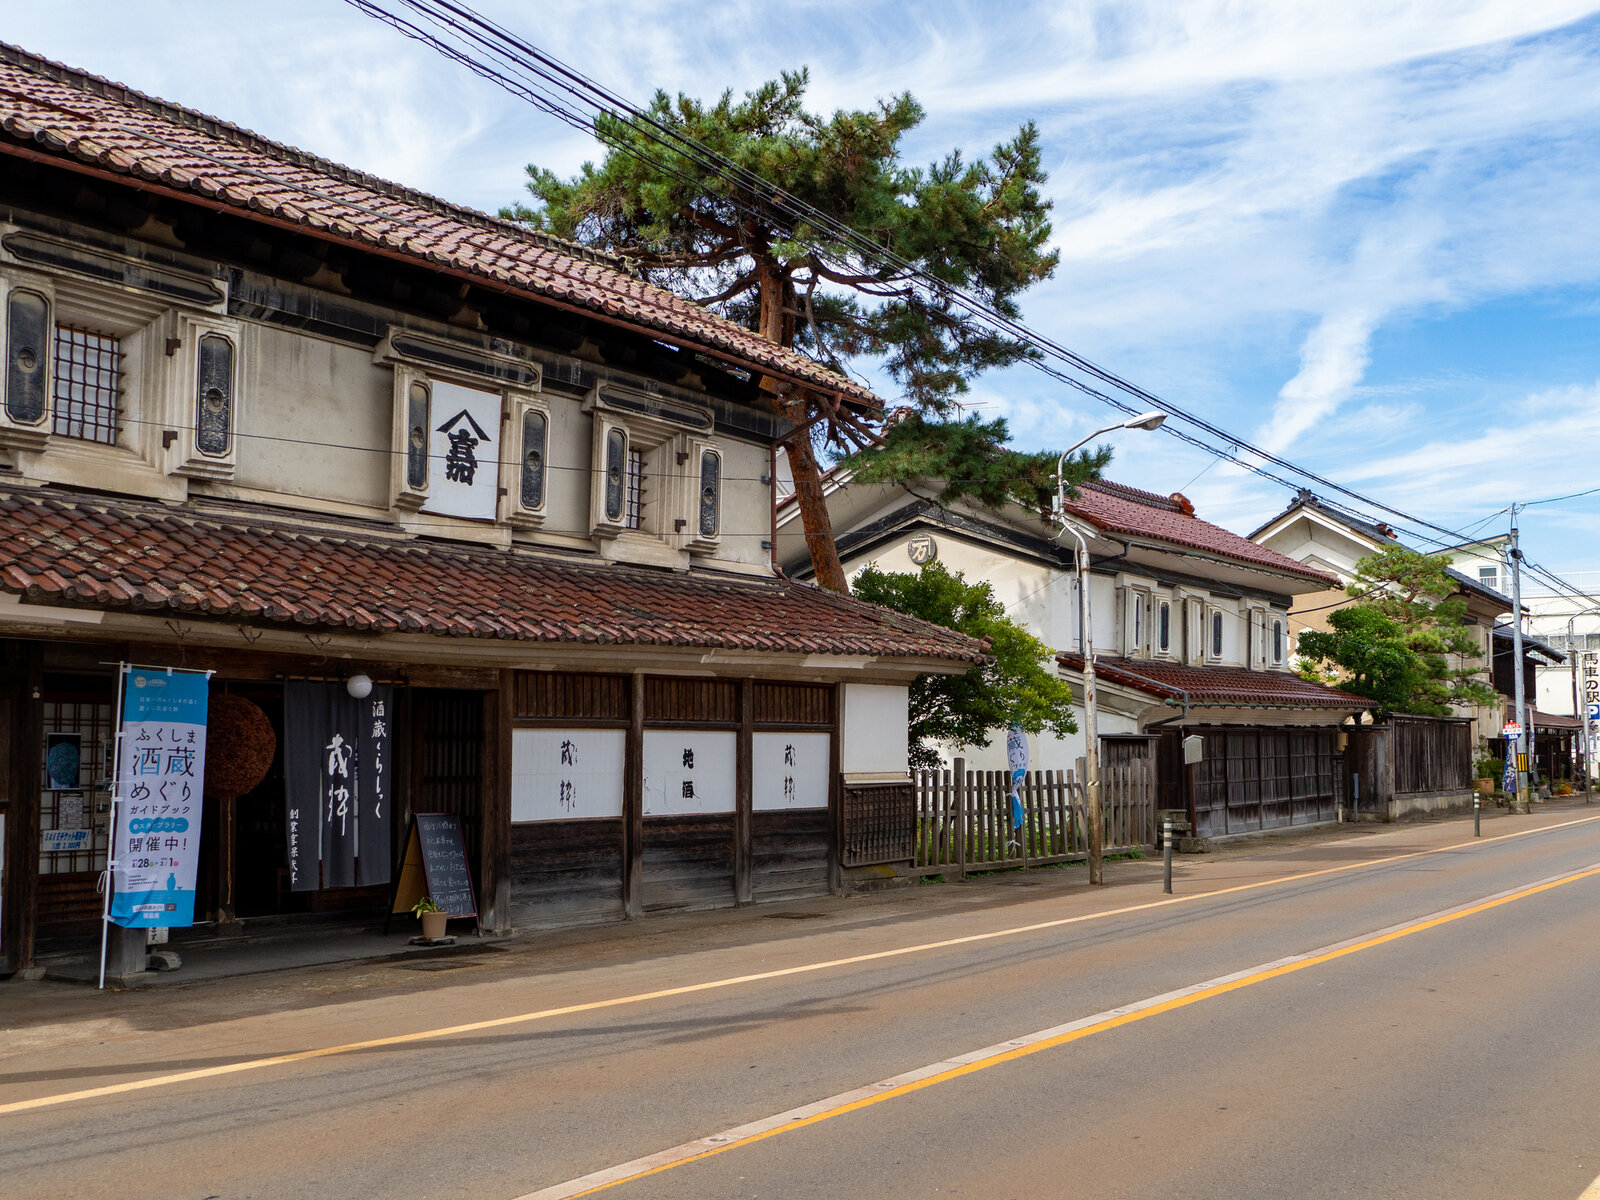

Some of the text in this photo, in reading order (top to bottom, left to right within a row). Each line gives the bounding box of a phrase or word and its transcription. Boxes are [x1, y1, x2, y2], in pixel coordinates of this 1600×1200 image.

[136, 728, 196, 744] ふくしま
[133, 746, 195, 777] 酒蔵
[682, 748, 695, 799] 地酒
[130, 781, 191, 802] めぐり
[130, 805, 190, 815] ガイドブック
